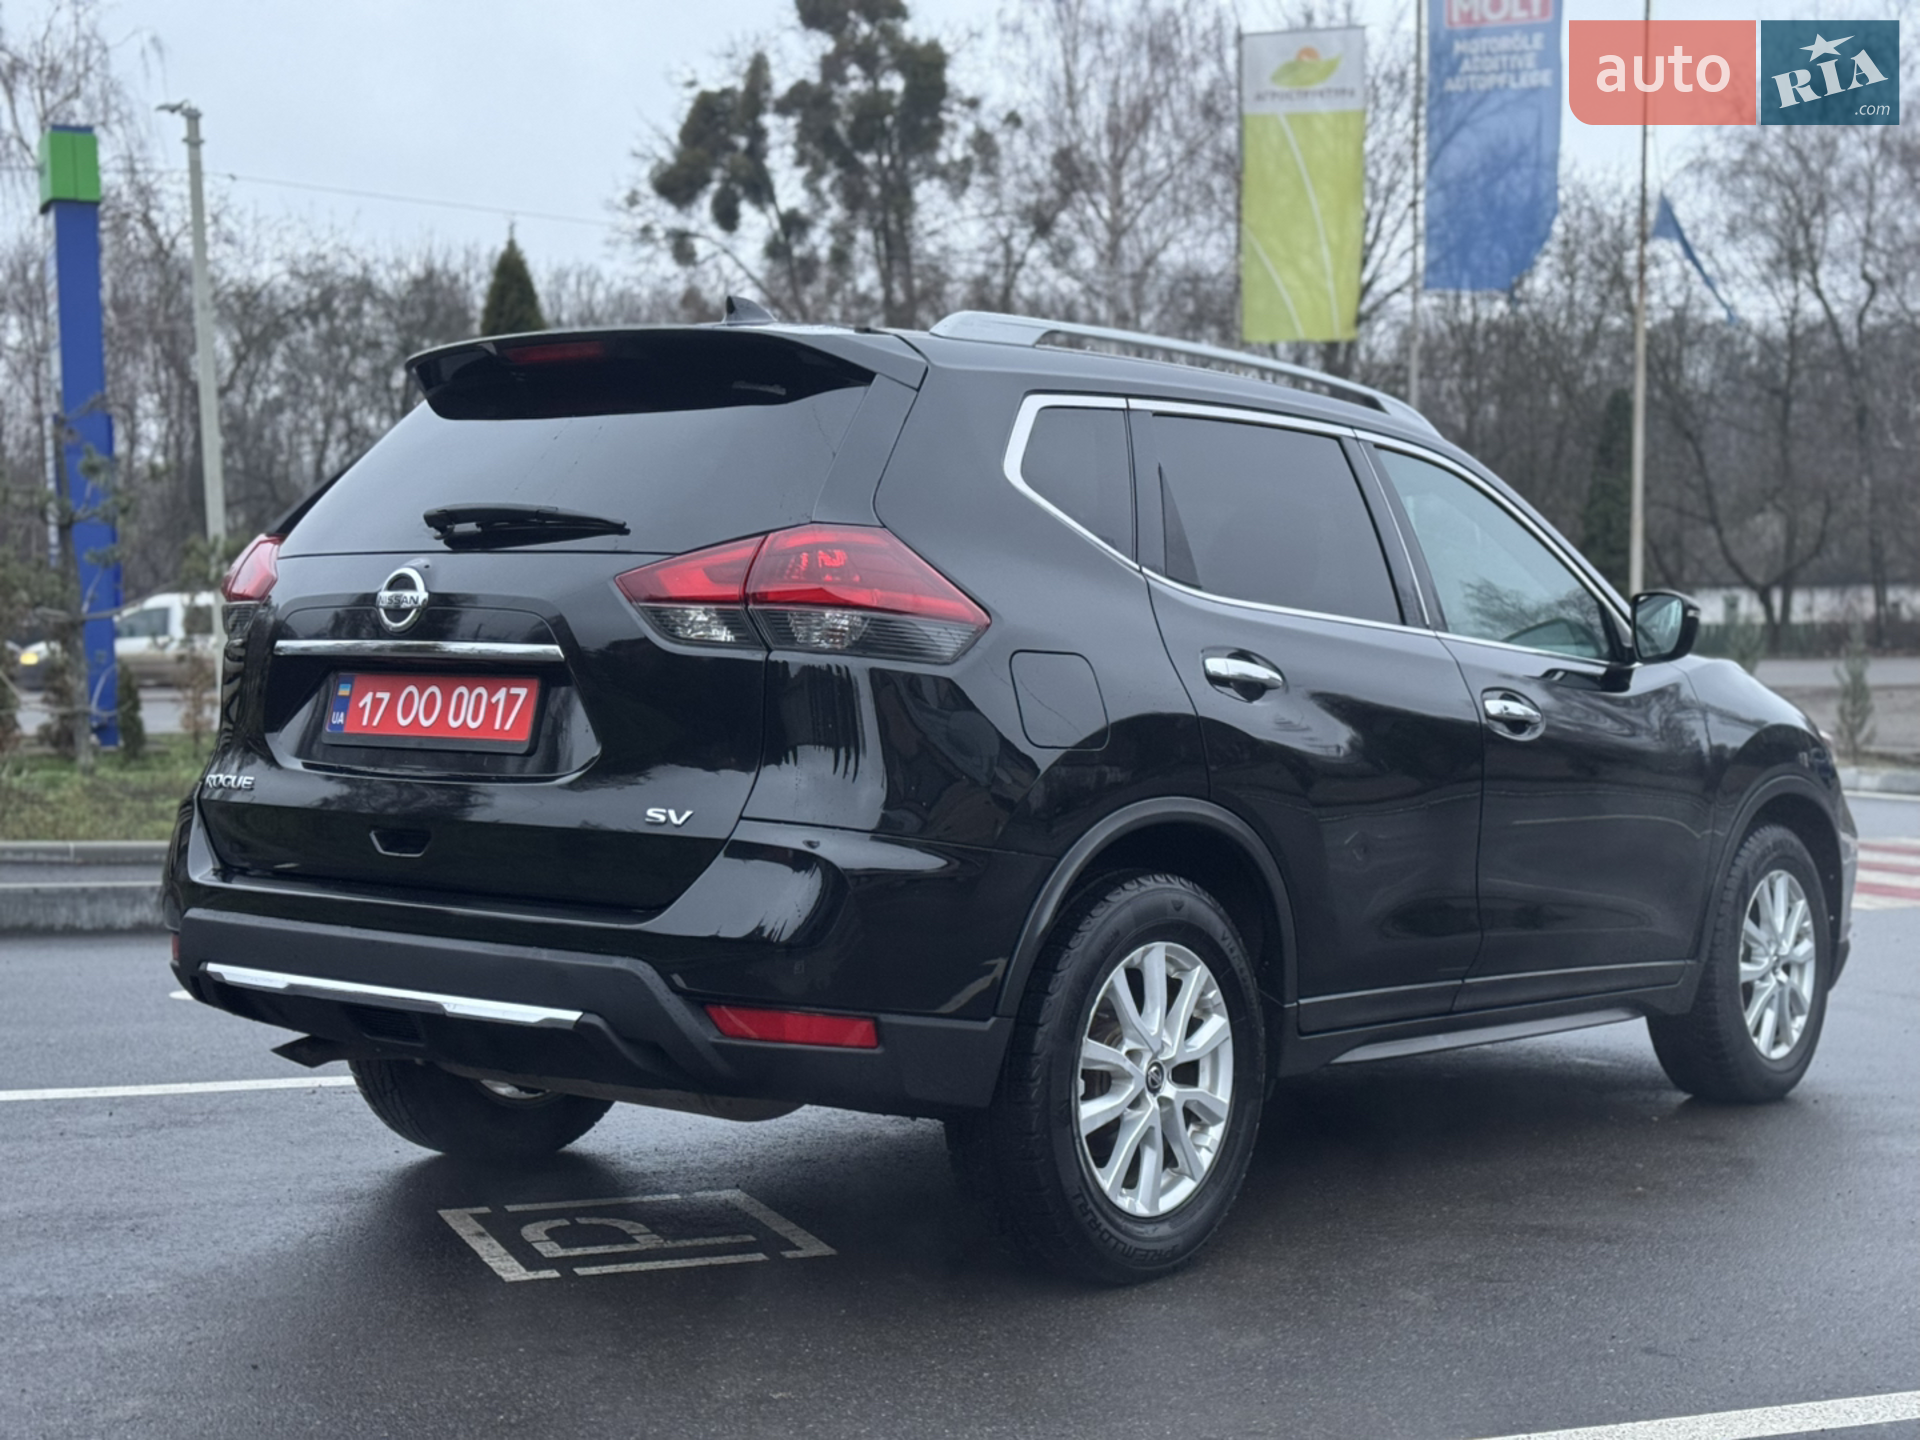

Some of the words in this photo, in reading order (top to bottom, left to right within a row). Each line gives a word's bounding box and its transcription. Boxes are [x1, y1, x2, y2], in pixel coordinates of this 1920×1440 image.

[379, 595, 419, 605] NISSAN
[358, 691, 391, 727] 17
[448, 686, 528, 731] 0017
[331, 711, 344, 724] UA
[206, 773, 255, 789] ROGUE
[645, 808, 694, 825] SV
